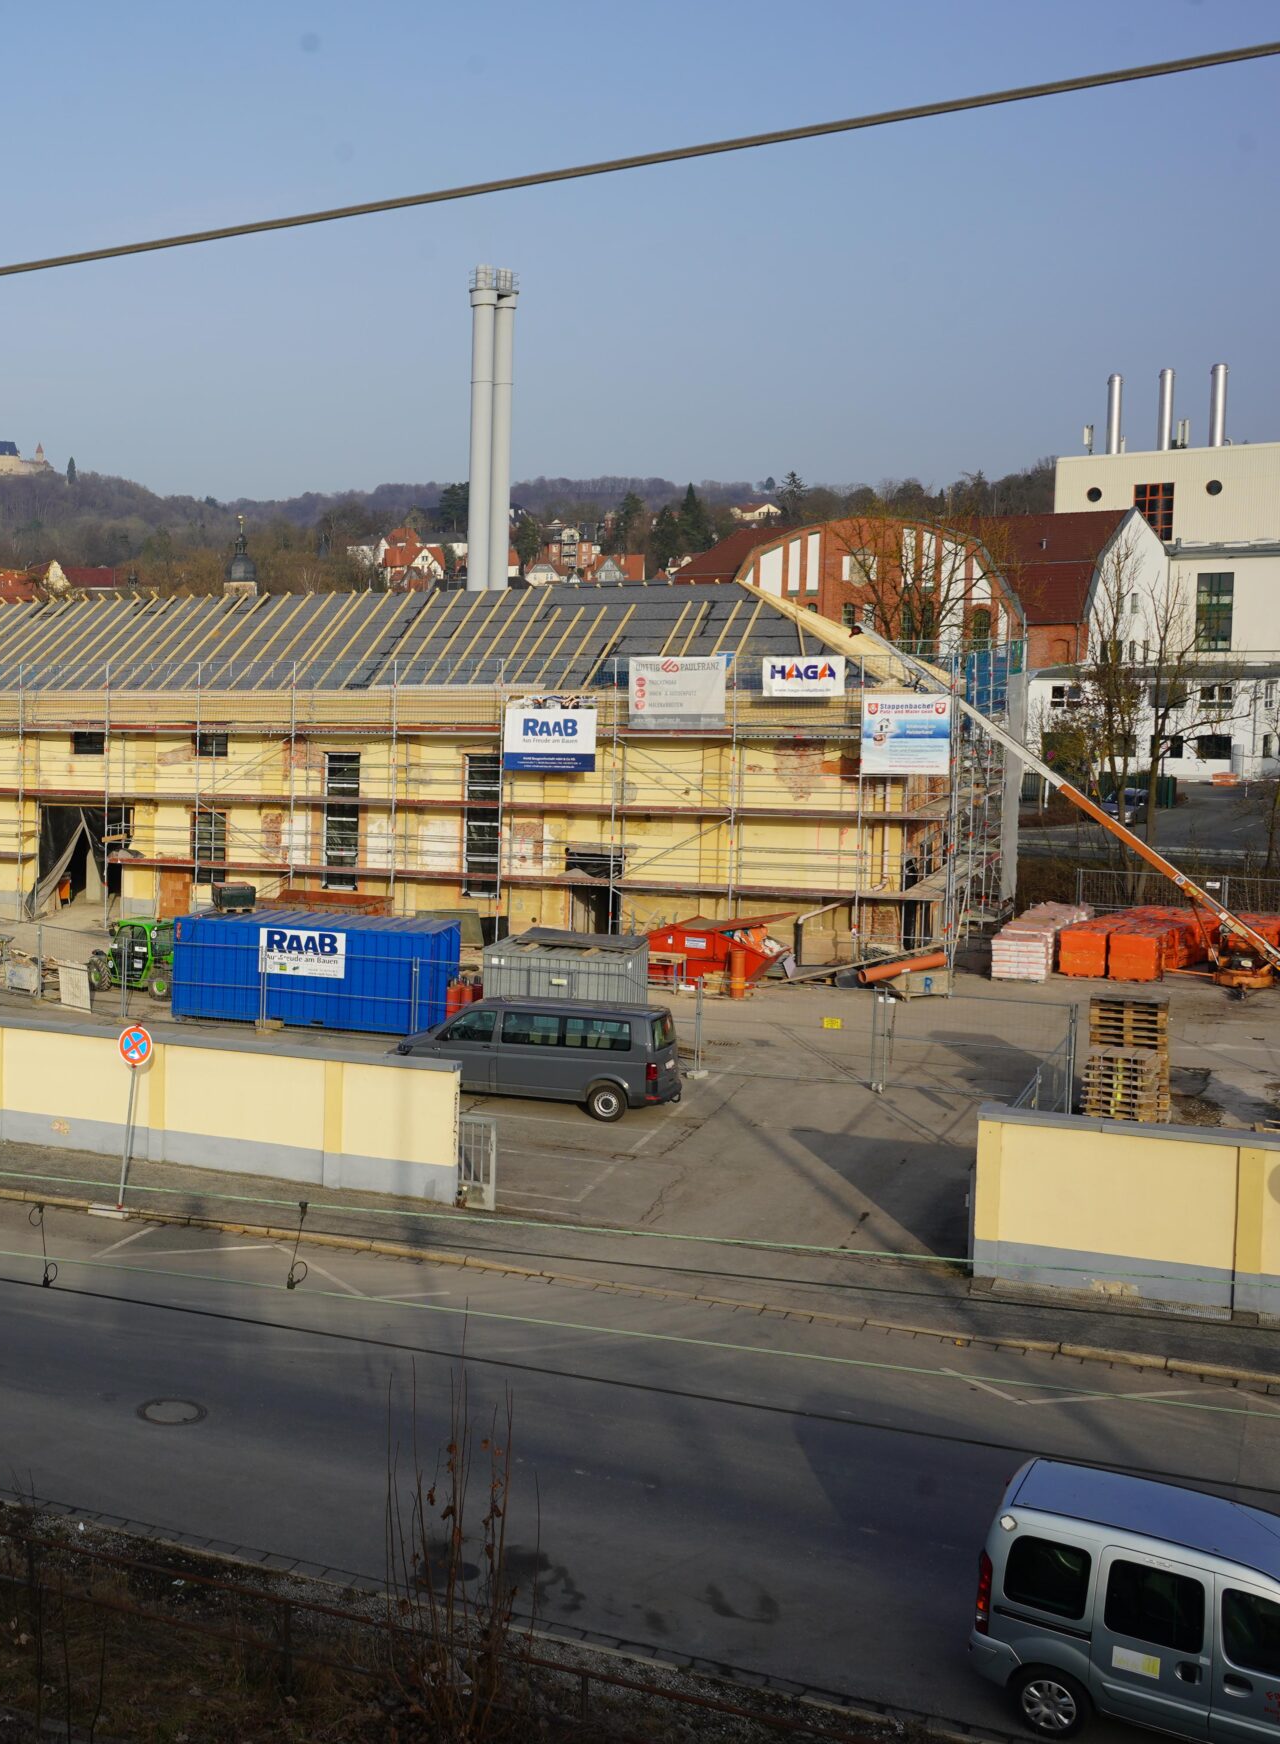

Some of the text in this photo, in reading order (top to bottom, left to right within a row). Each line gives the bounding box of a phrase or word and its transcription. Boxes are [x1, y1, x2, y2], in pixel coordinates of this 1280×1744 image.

[680, 662, 720, 672] PAULFRANZ
[770, 662, 836, 681] HAGA
[880, 703, 934, 711] Stappenbacher
[522, 718, 578, 737] RAAB
[267, 930, 339, 957] RAAB
[316, 957, 339, 965] Bauen
